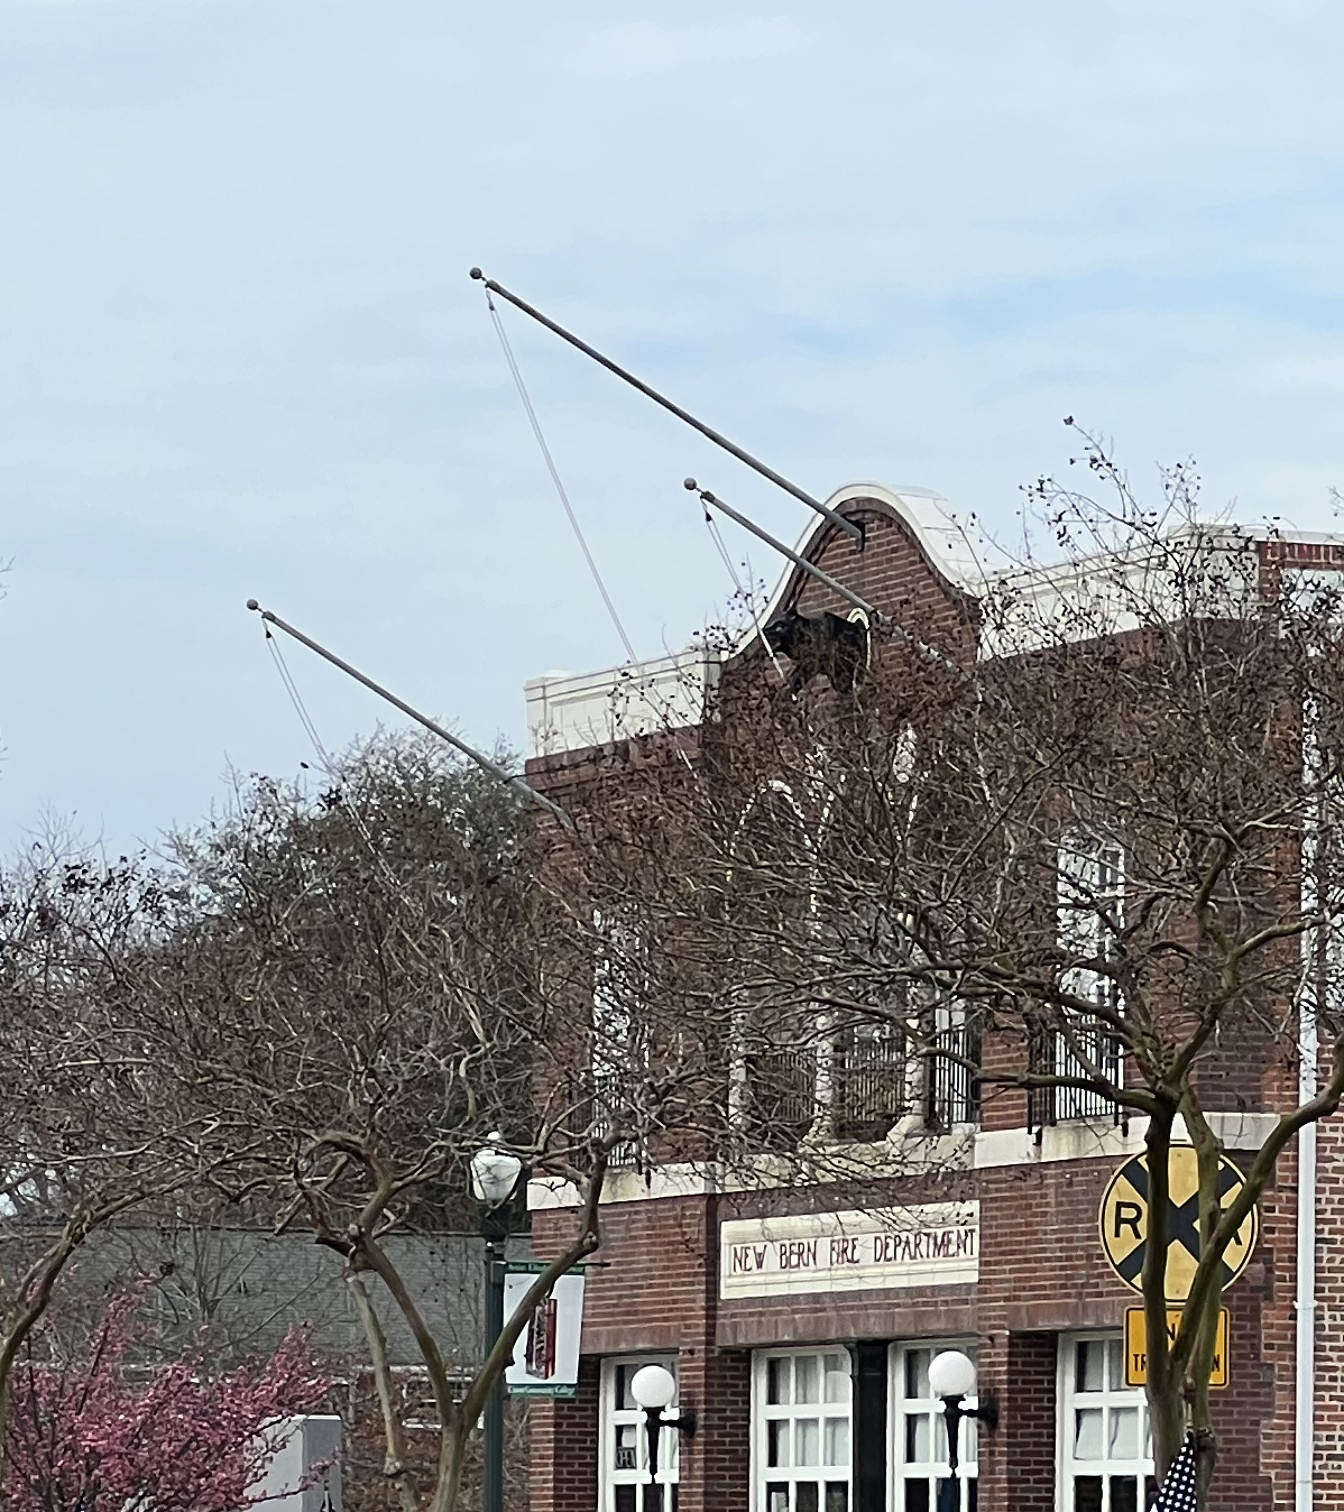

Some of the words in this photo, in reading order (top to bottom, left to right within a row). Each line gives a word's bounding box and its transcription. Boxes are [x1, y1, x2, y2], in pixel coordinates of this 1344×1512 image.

[1114, 1201, 1142, 1239] R
[732, 1244, 768, 1273] NEW
[779, 1238, 819, 1269] BERN
[829, 1237, 860, 1266] FIRE
[873, 1228, 977, 1263] DEPARTMENT
